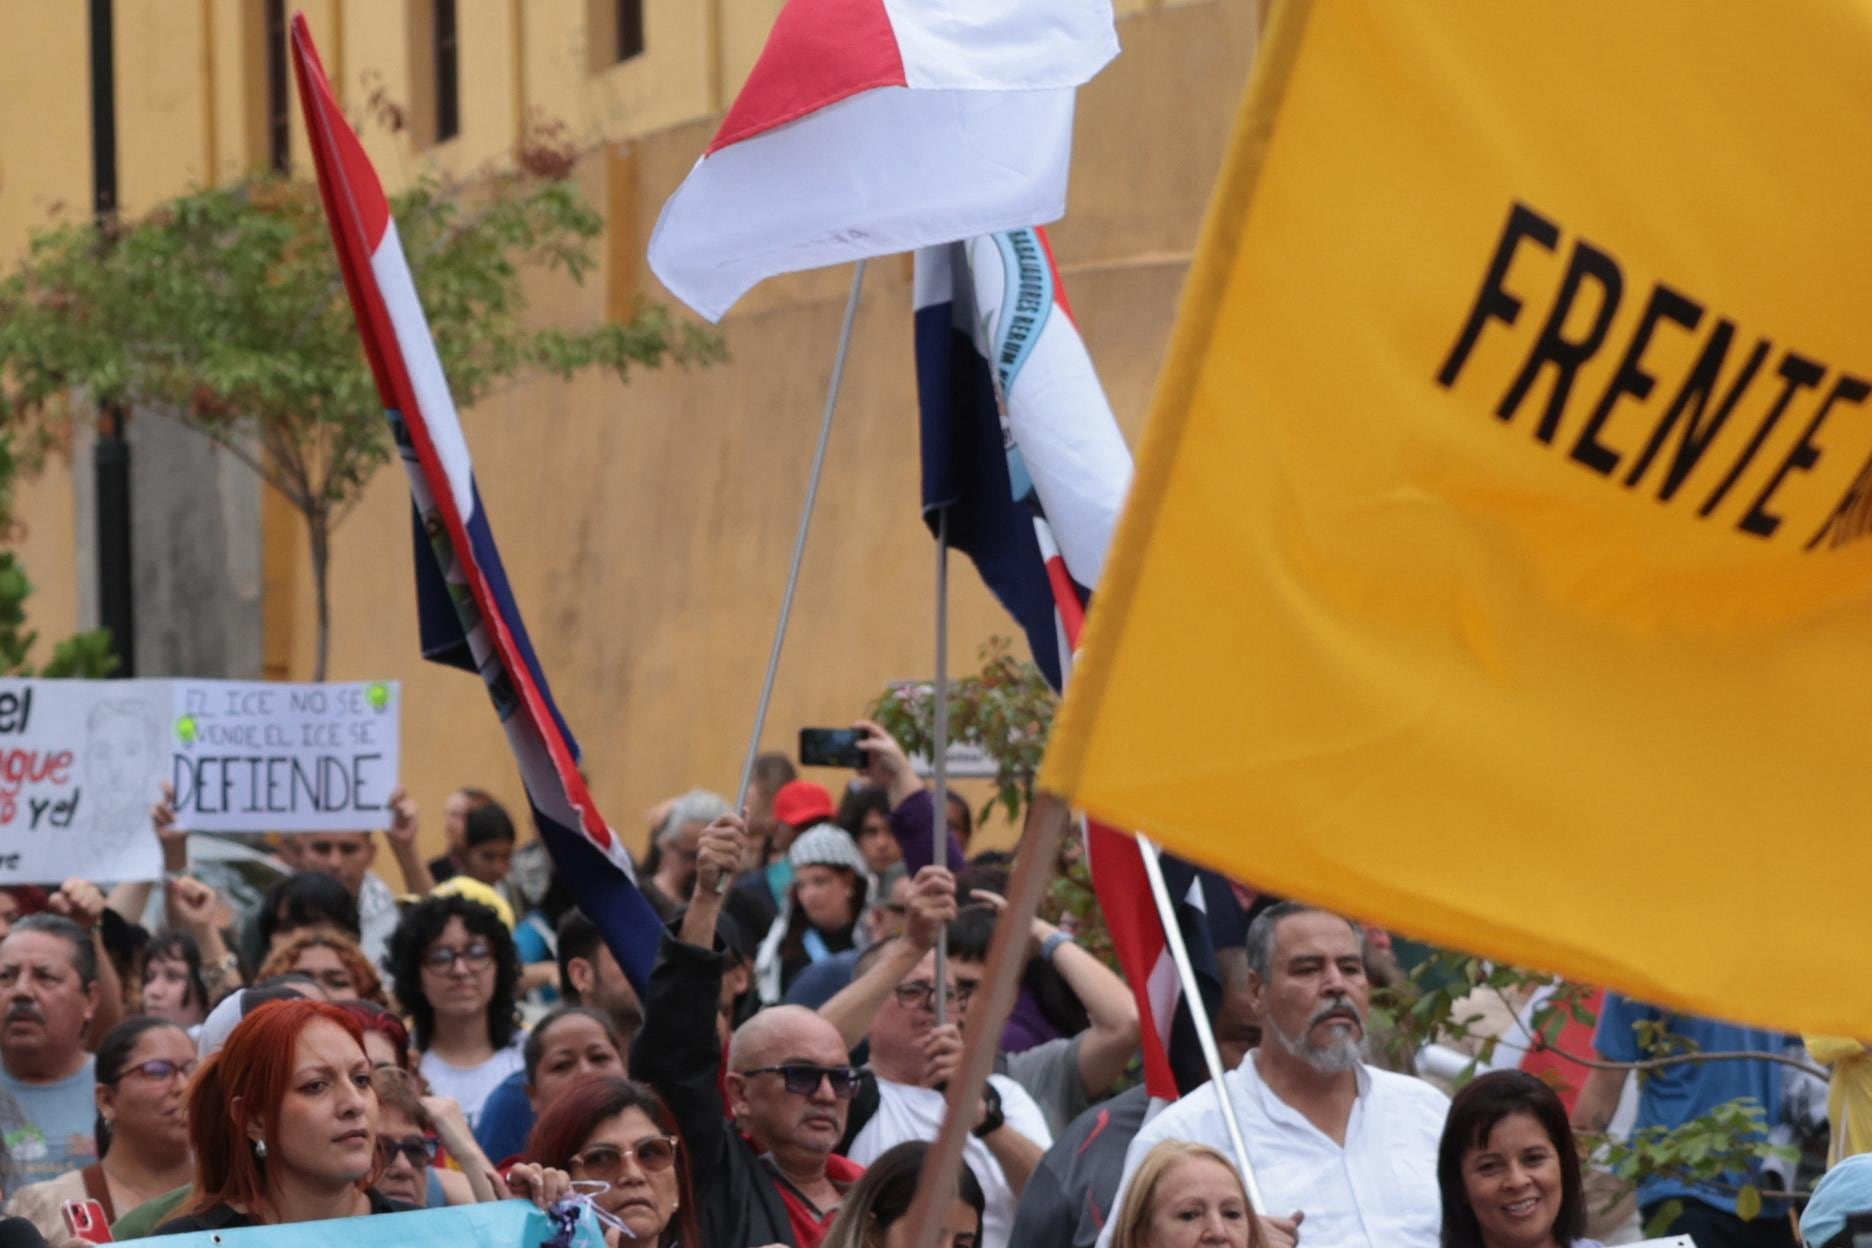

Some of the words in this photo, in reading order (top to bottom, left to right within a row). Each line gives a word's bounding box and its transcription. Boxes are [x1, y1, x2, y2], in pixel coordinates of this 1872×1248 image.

[1432, 197, 1872, 540] FRENTE
[225, 690, 276, 716] ICE
[289, 690, 328, 715] NO
[335, 689, 365, 717] SE
[301, 722, 344, 748] ICE
[348, 721, 378, 745] SE
